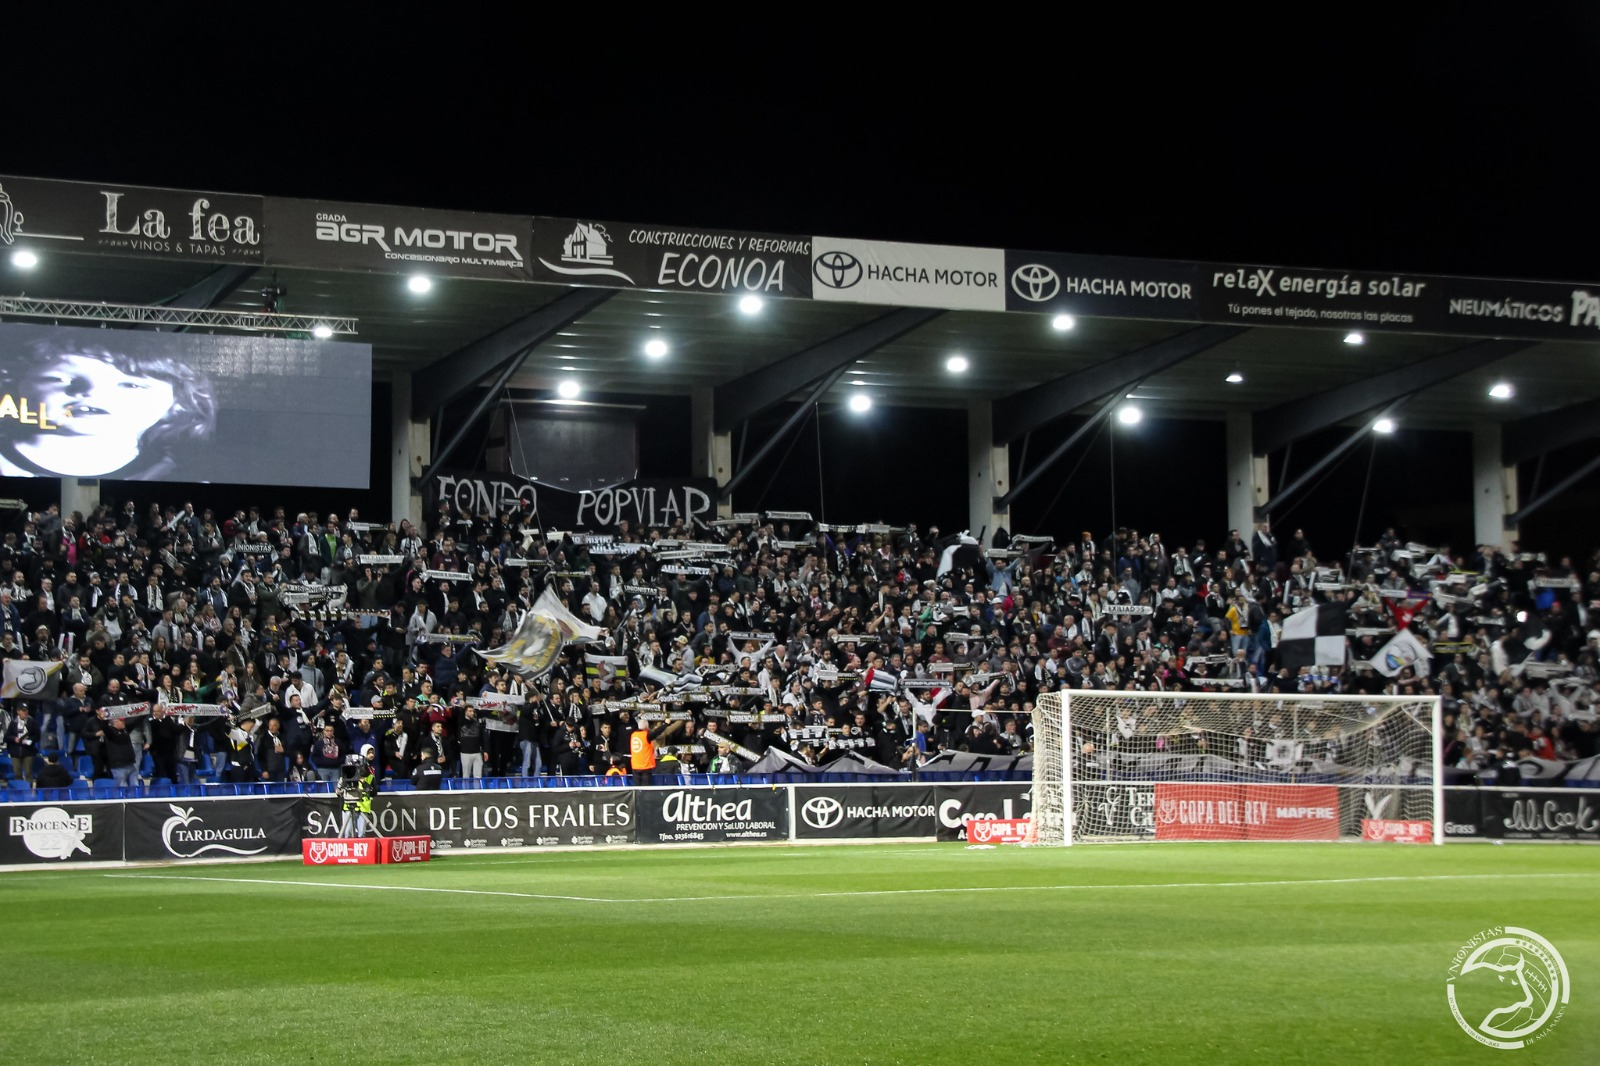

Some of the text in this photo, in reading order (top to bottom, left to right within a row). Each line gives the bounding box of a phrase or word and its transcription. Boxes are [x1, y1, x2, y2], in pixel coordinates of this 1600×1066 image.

[98, 191, 260, 246] La fea
[316, 213, 347, 223] GRADA
[130, 240, 226, 256] VINOS & TAPAS
[394, 227, 523, 261] MOTOR
[628, 229, 812, 255] CONSTRUCCIONES Y REFORMAS
[657, 251, 785, 292] ECONOA
[867, 264, 999, 288] HACHA MOTOR
[1066, 277, 1192, 300] HACHA MOTOR
[1280, 273, 1362, 299] energía
[1367, 277, 1426, 298] solar
[1227, 303, 1241, 315] Tú
[1242, 306, 1273, 318] pones
[1274, 306, 1282, 316] el
[1284, 306, 1319, 320] tejado,
[1449, 297, 1565, 323] NEUMÁTICOS
[307, 801, 631, 835] SADÓN DE LOS FRAILES
[847, 805, 935, 818] HACHA MOTOR
[1180, 800, 1334, 824] COPA DEL REY MAPFRE
[12, 816, 90, 833] BROCENSE
[676, 823, 717, 831] PREVENCION
[746, 821, 776, 830] LABORAL
[1444, 822, 1476, 834] Grass
[328, 842, 369, 857] COPA REY
